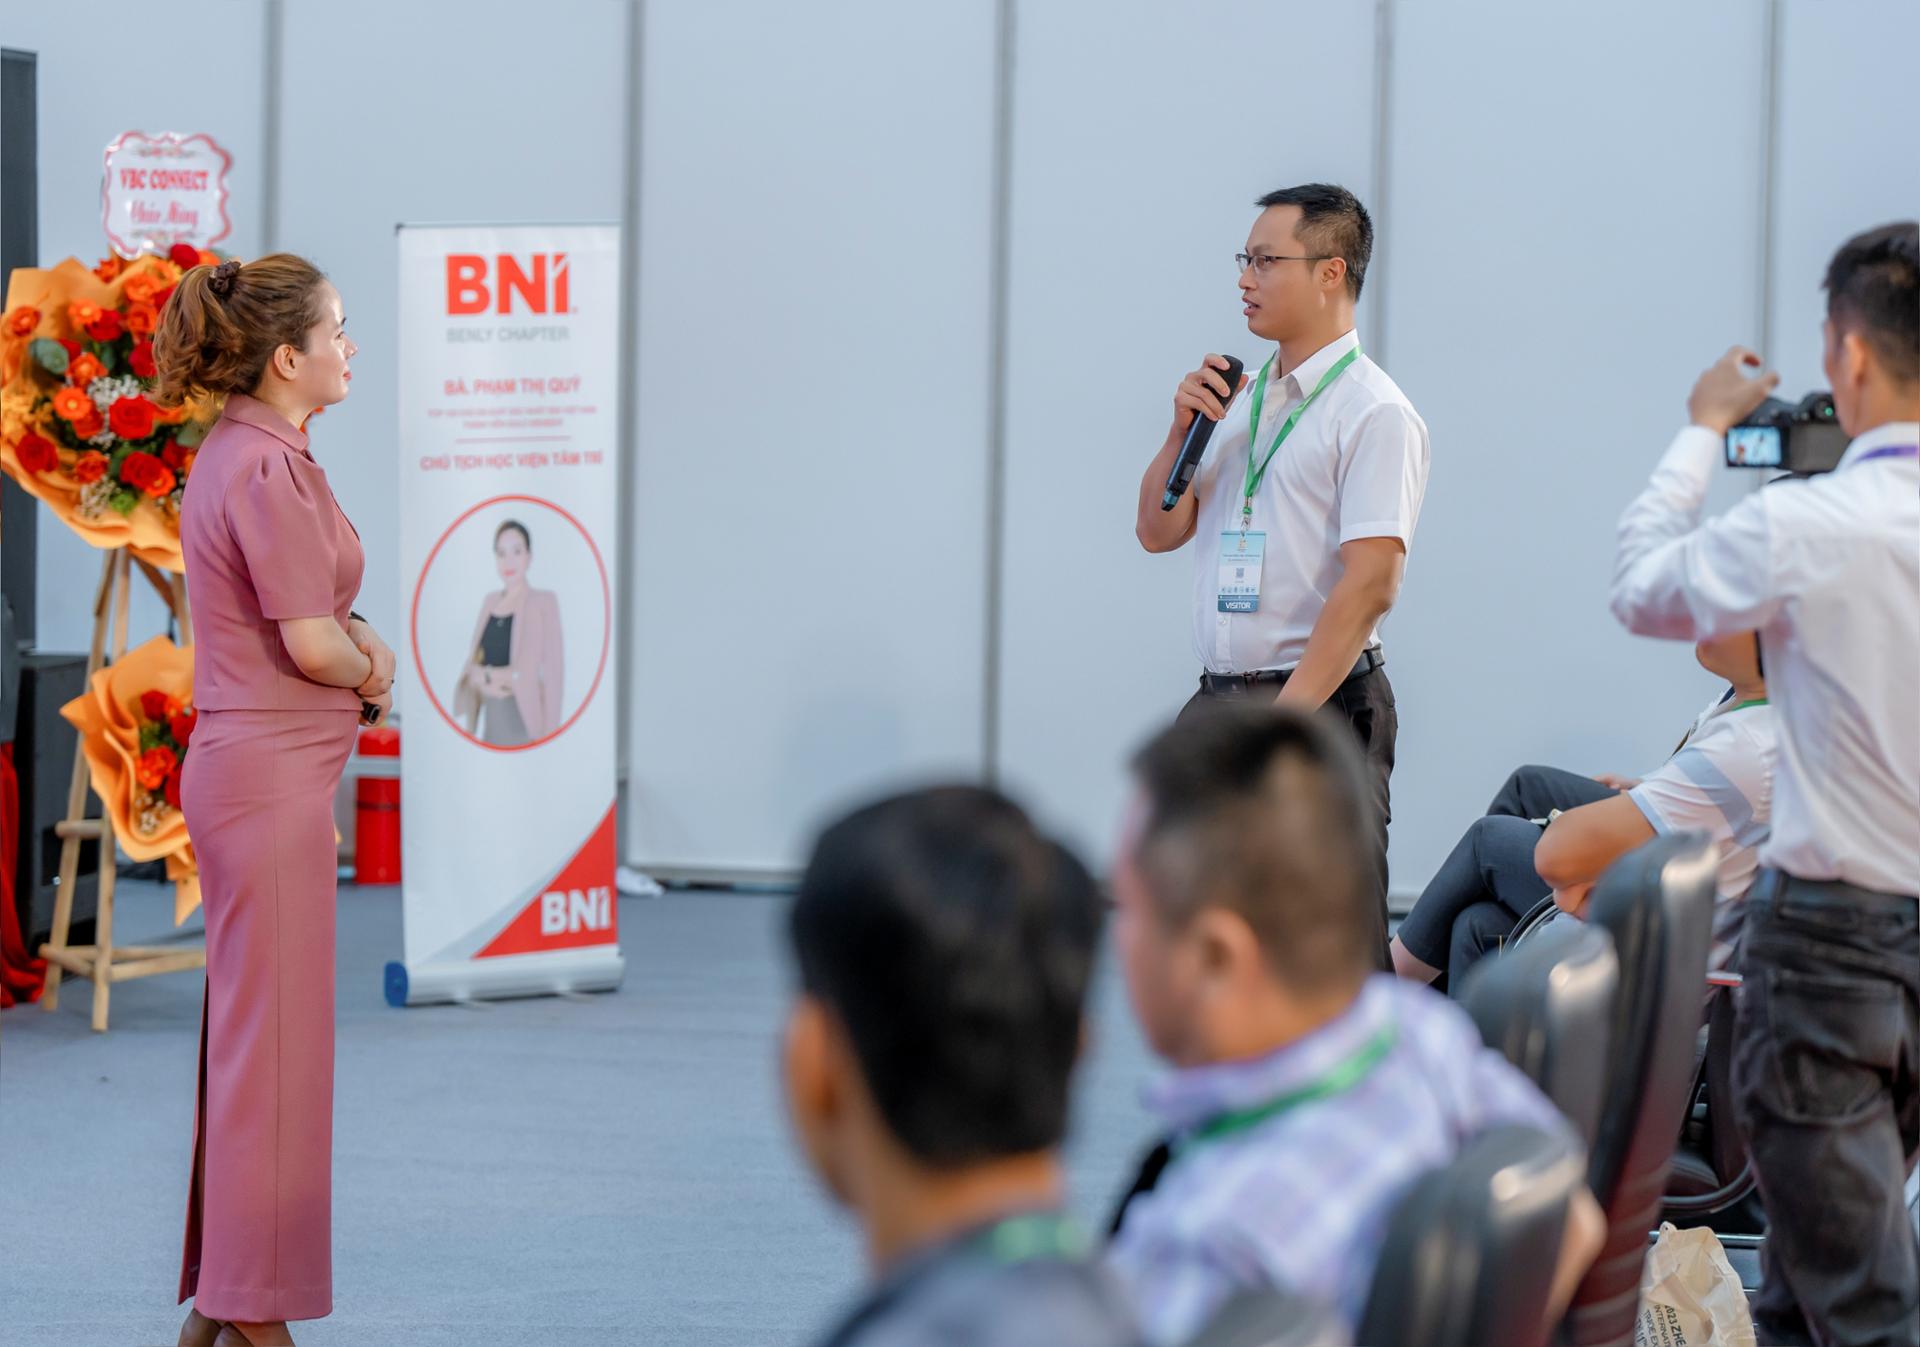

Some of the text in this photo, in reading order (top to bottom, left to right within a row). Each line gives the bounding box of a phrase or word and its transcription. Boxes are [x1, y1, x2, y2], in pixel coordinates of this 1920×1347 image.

[120, 168, 208, 191] VBC CONNECT
[447, 326, 570, 343] BENLY CHAPTER
[1225, 601, 1251, 609] VISITOR
